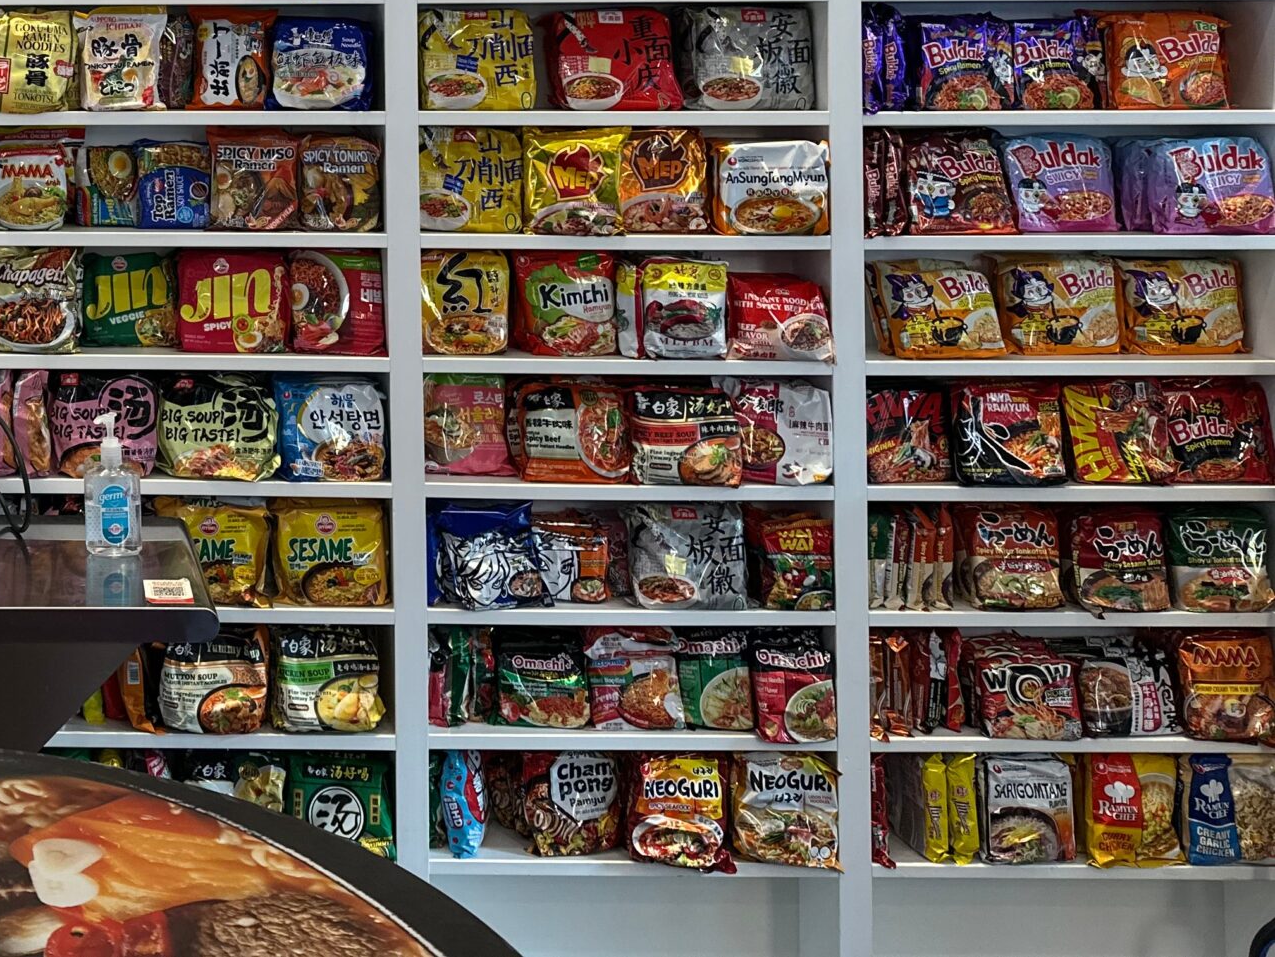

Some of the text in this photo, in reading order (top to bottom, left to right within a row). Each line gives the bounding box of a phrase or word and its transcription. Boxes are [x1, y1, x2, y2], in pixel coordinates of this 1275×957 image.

[23, 32, 60, 44] RAMEN
[923, 41, 985, 69] Buldak
[258, 146, 296, 161] MISO
[1, 163, 55, 179] MAMA
[234, 158, 276, 172] Ramen
[322, 161, 367, 174] Ramen
[540, 283, 610, 310] Kimchi
[109, 310, 147, 324] VEGGIE
[204, 321, 232, 332] SPICY
[165, 426, 189, 443] BIG
[1168, 414, 1235, 445] Buldak
[286, 538, 353, 563] SESAME
[512, 654, 566, 672] Omachi
[1193, 645, 1261, 668] MAMA
[196, 672, 218, 681] SOUP
[307, 667, 330, 678] SOUP
[557, 762, 613, 780] Cham
[557, 777, 614, 802] pong
[643, 777, 720, 800] NEOGURI
[1200, 837, 1230, 848] GARLIC
[1197, 846, 1235, 857] CHICKEN
